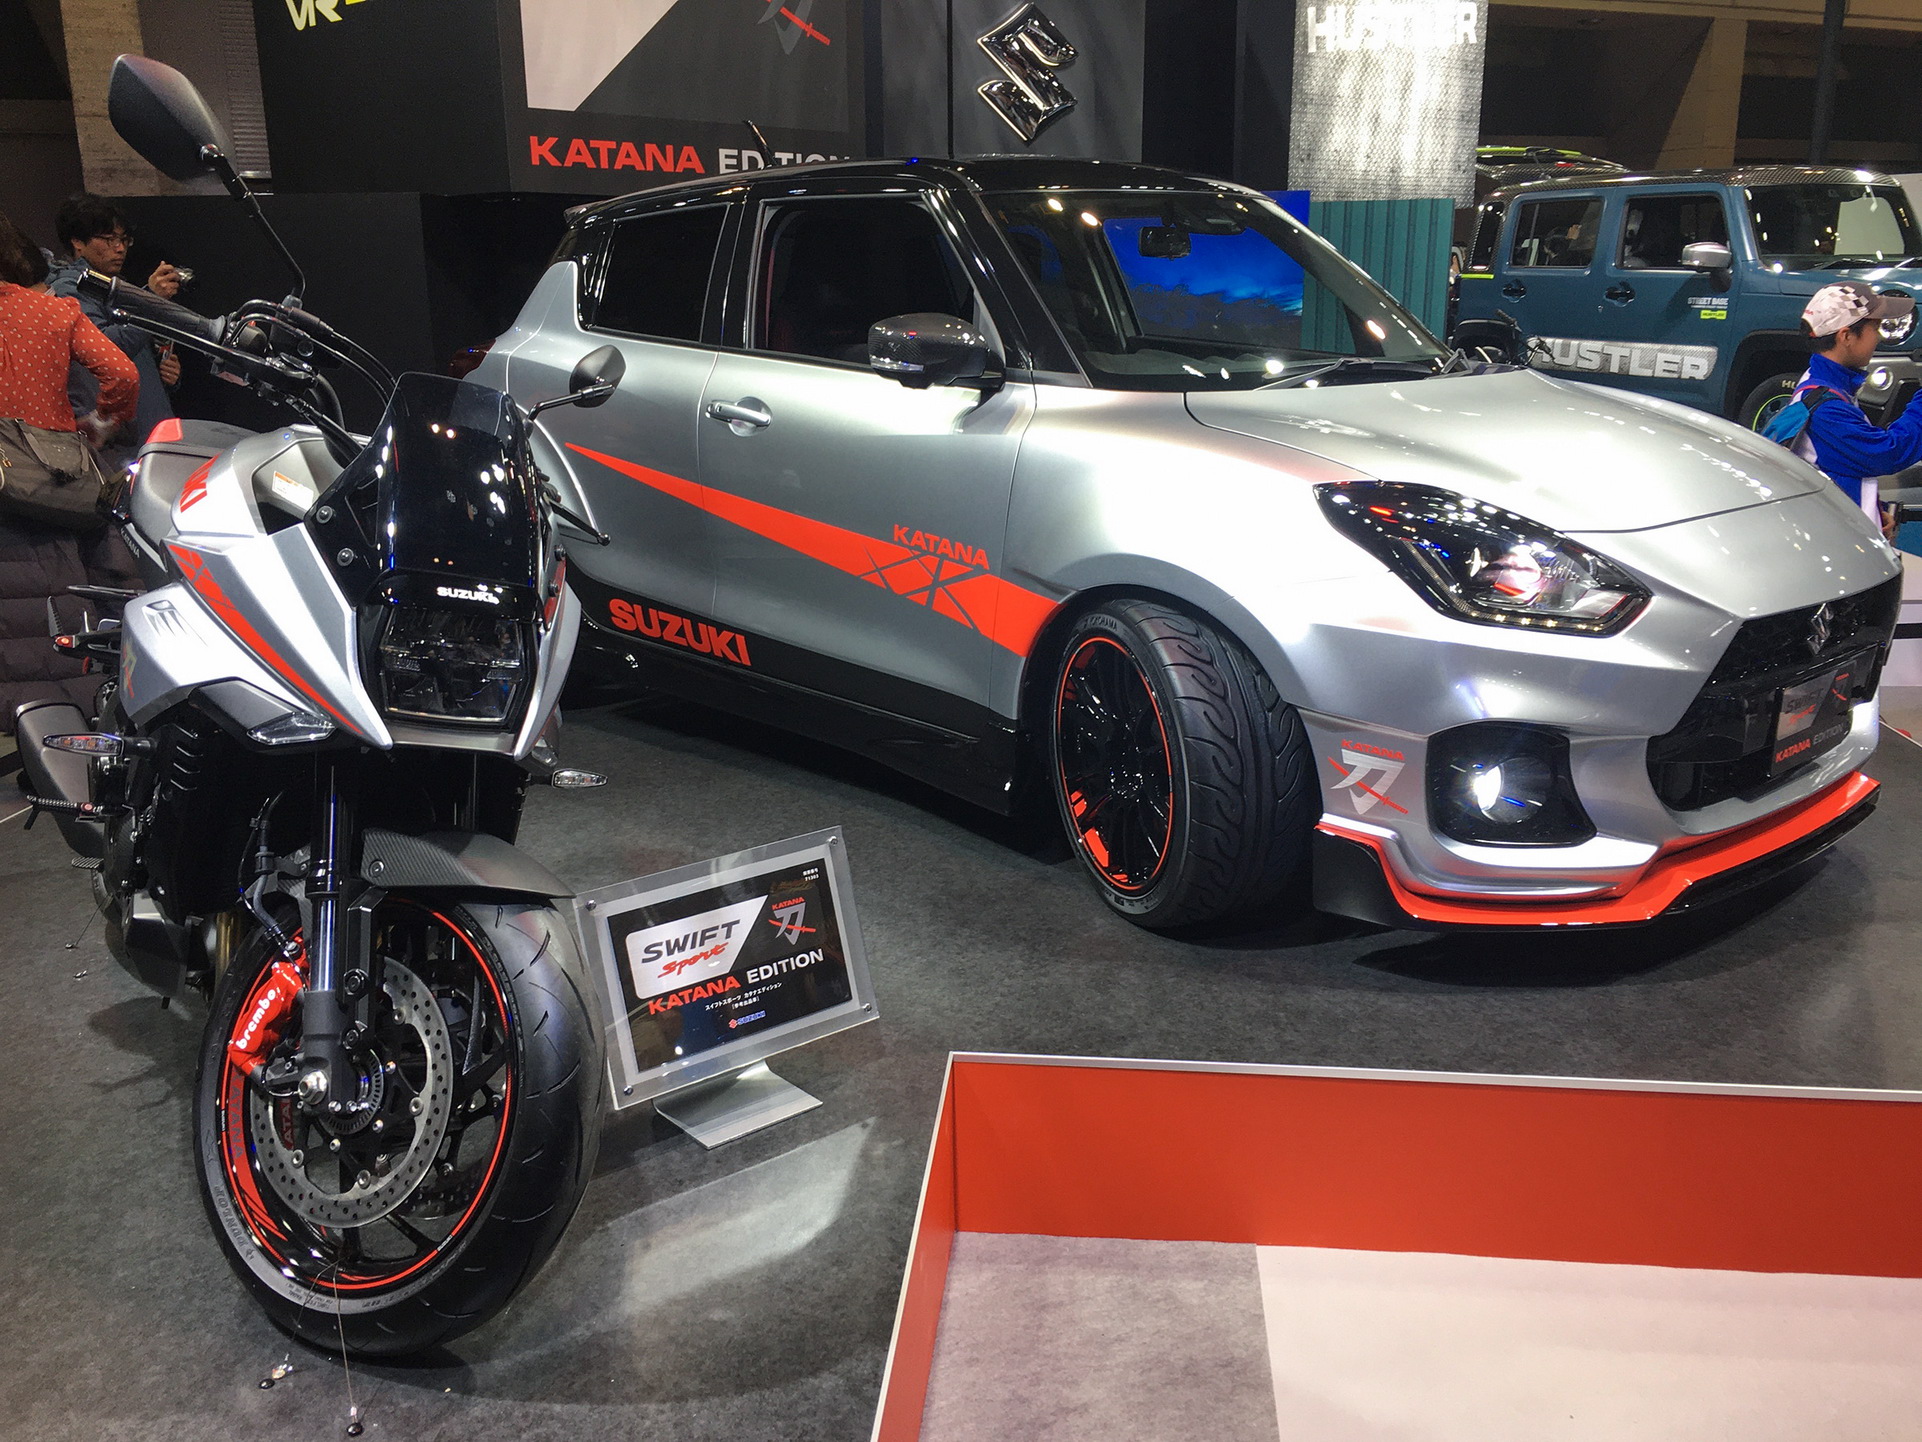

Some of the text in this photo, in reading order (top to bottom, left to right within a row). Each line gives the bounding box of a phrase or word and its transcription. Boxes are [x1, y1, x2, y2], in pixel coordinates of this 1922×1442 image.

[1307, 2, 1478, 53] HUSTR
[529, 135, 850, 174] KATANA EDTI
[1687, 296, 1729, 306] STREET BASE
[893, 524, 990, 570] KATANA
[436, 586, 495, 603] SUZUKI
[608, 598, 752, 666] SUZUKI
[1341, 739, 1406, 761] KATANA
[1775, 738, 1812, 763] KATANA
[771, 896, 805, 911] KATANA
[641, 919, 741, 964] SWIFT
[657, 942, 729, 978] Sport
[648, 948, 825, 1015] KATANA EDITION
[235, 989, 277, 1050] brembo
